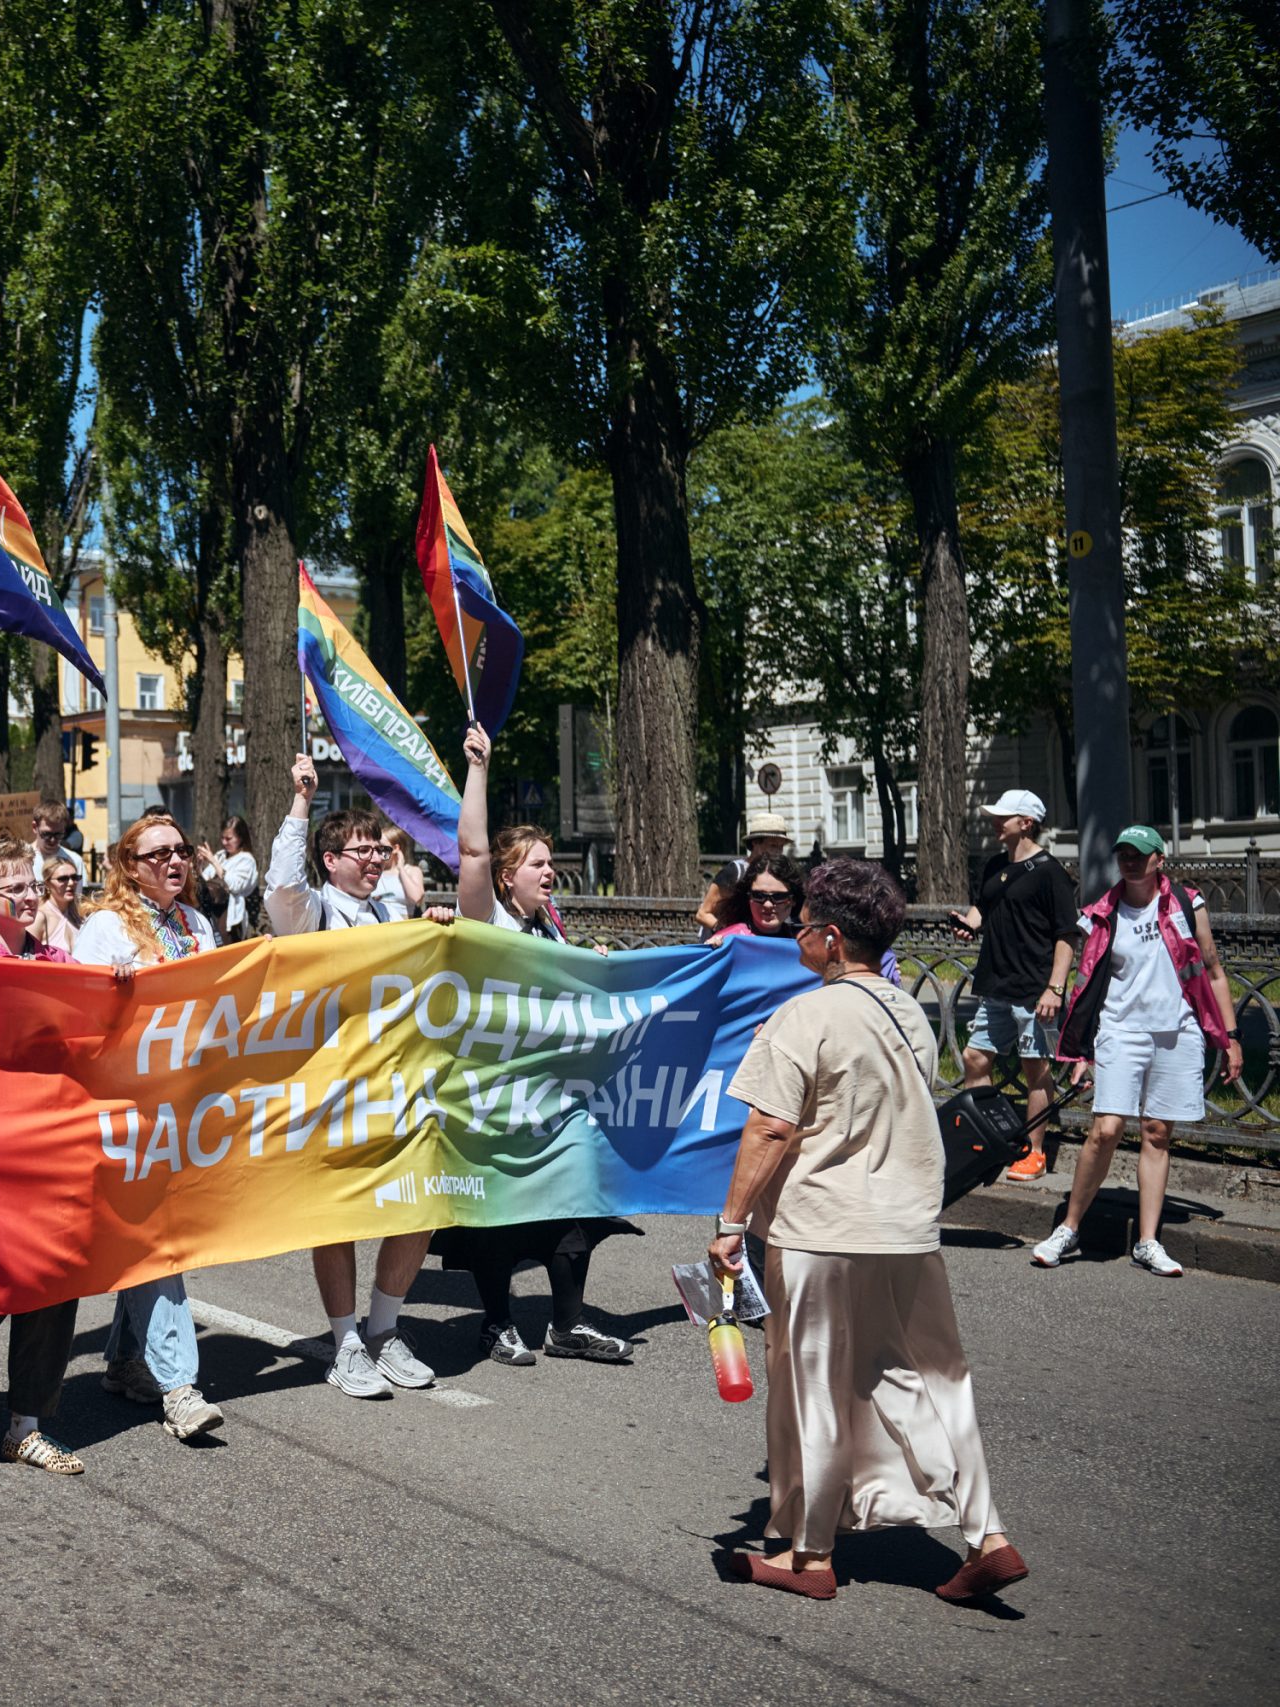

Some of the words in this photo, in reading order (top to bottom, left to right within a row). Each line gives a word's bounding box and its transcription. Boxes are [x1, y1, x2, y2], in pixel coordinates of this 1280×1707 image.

[136, 983, 348, 1076] НАШІ
[98, 1067, 448, 1182] ЧАСТИНА
[463, 1049, 725, 1138] УКРАЇНИ
